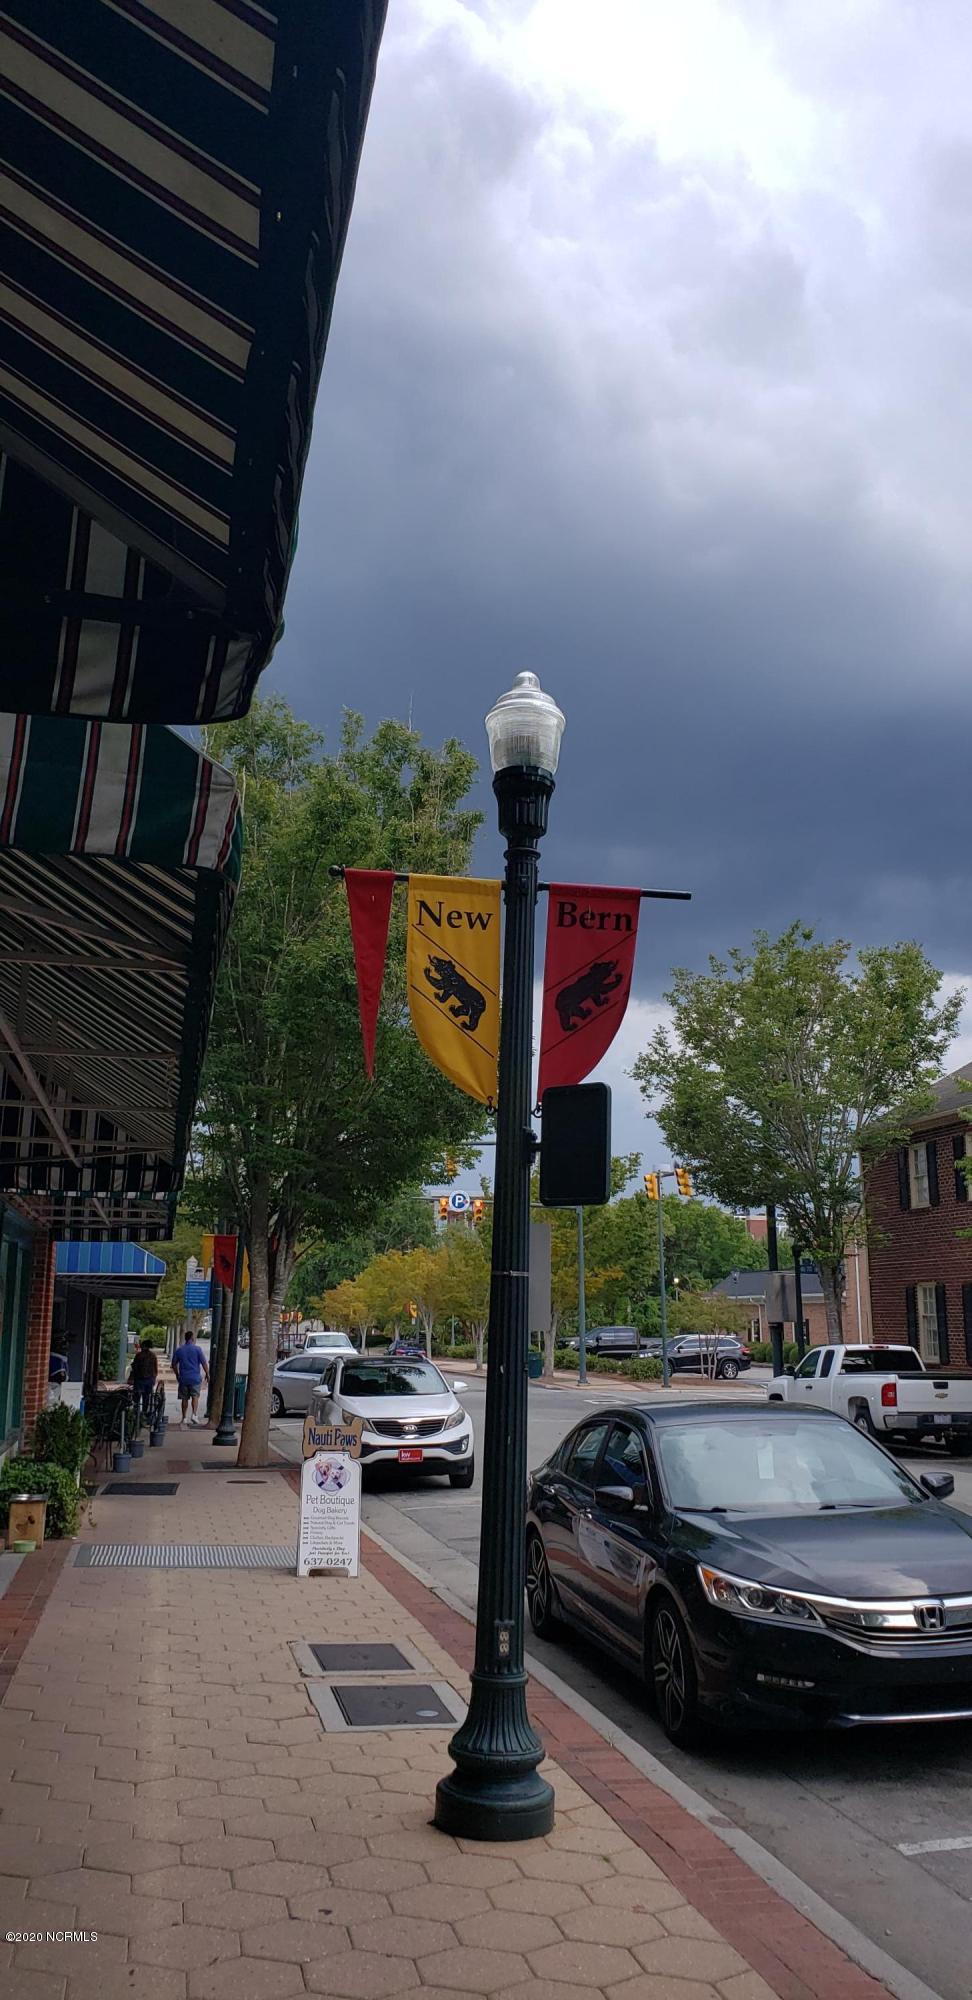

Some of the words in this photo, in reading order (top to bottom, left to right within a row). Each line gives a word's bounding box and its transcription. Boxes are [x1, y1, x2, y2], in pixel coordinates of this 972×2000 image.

[416, 900, 493, 931] New
[557, 901, 633, 932] Bern
[308, 1427, 333, 1446] Nauti
[334, 1428, 358, 1447] Paws
[306, 1494, 319, 1505] Pet
[320, 1494, 355, 1507] Boutique
[313, 1506, 326, 1515] Dog
[327, 1506, 347, 1514] Bakery
[303, 1557, 353, 1566] 637-0247
